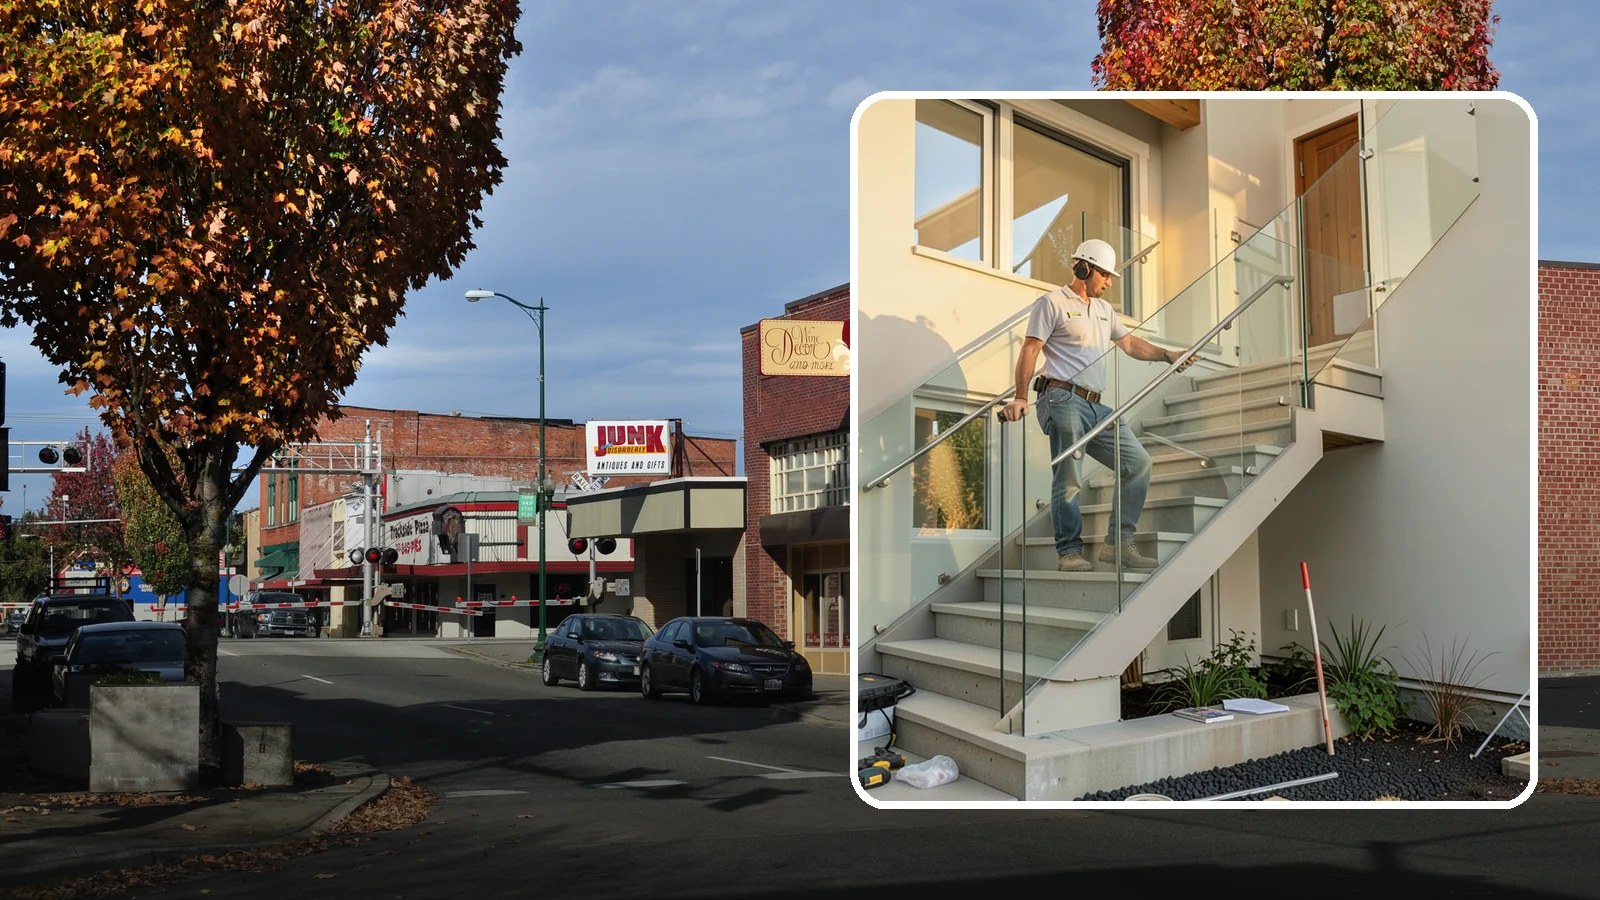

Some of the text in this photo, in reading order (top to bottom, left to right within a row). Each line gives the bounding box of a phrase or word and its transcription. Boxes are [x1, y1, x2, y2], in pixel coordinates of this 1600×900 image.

[596, 425, 665, 457] JUNK
[607, 446, 646, 454] DISORDERLY
[597, 460, 665, 470] ANTIQUES AND GIFTS
[414, 519, 429, 535] Pizza
